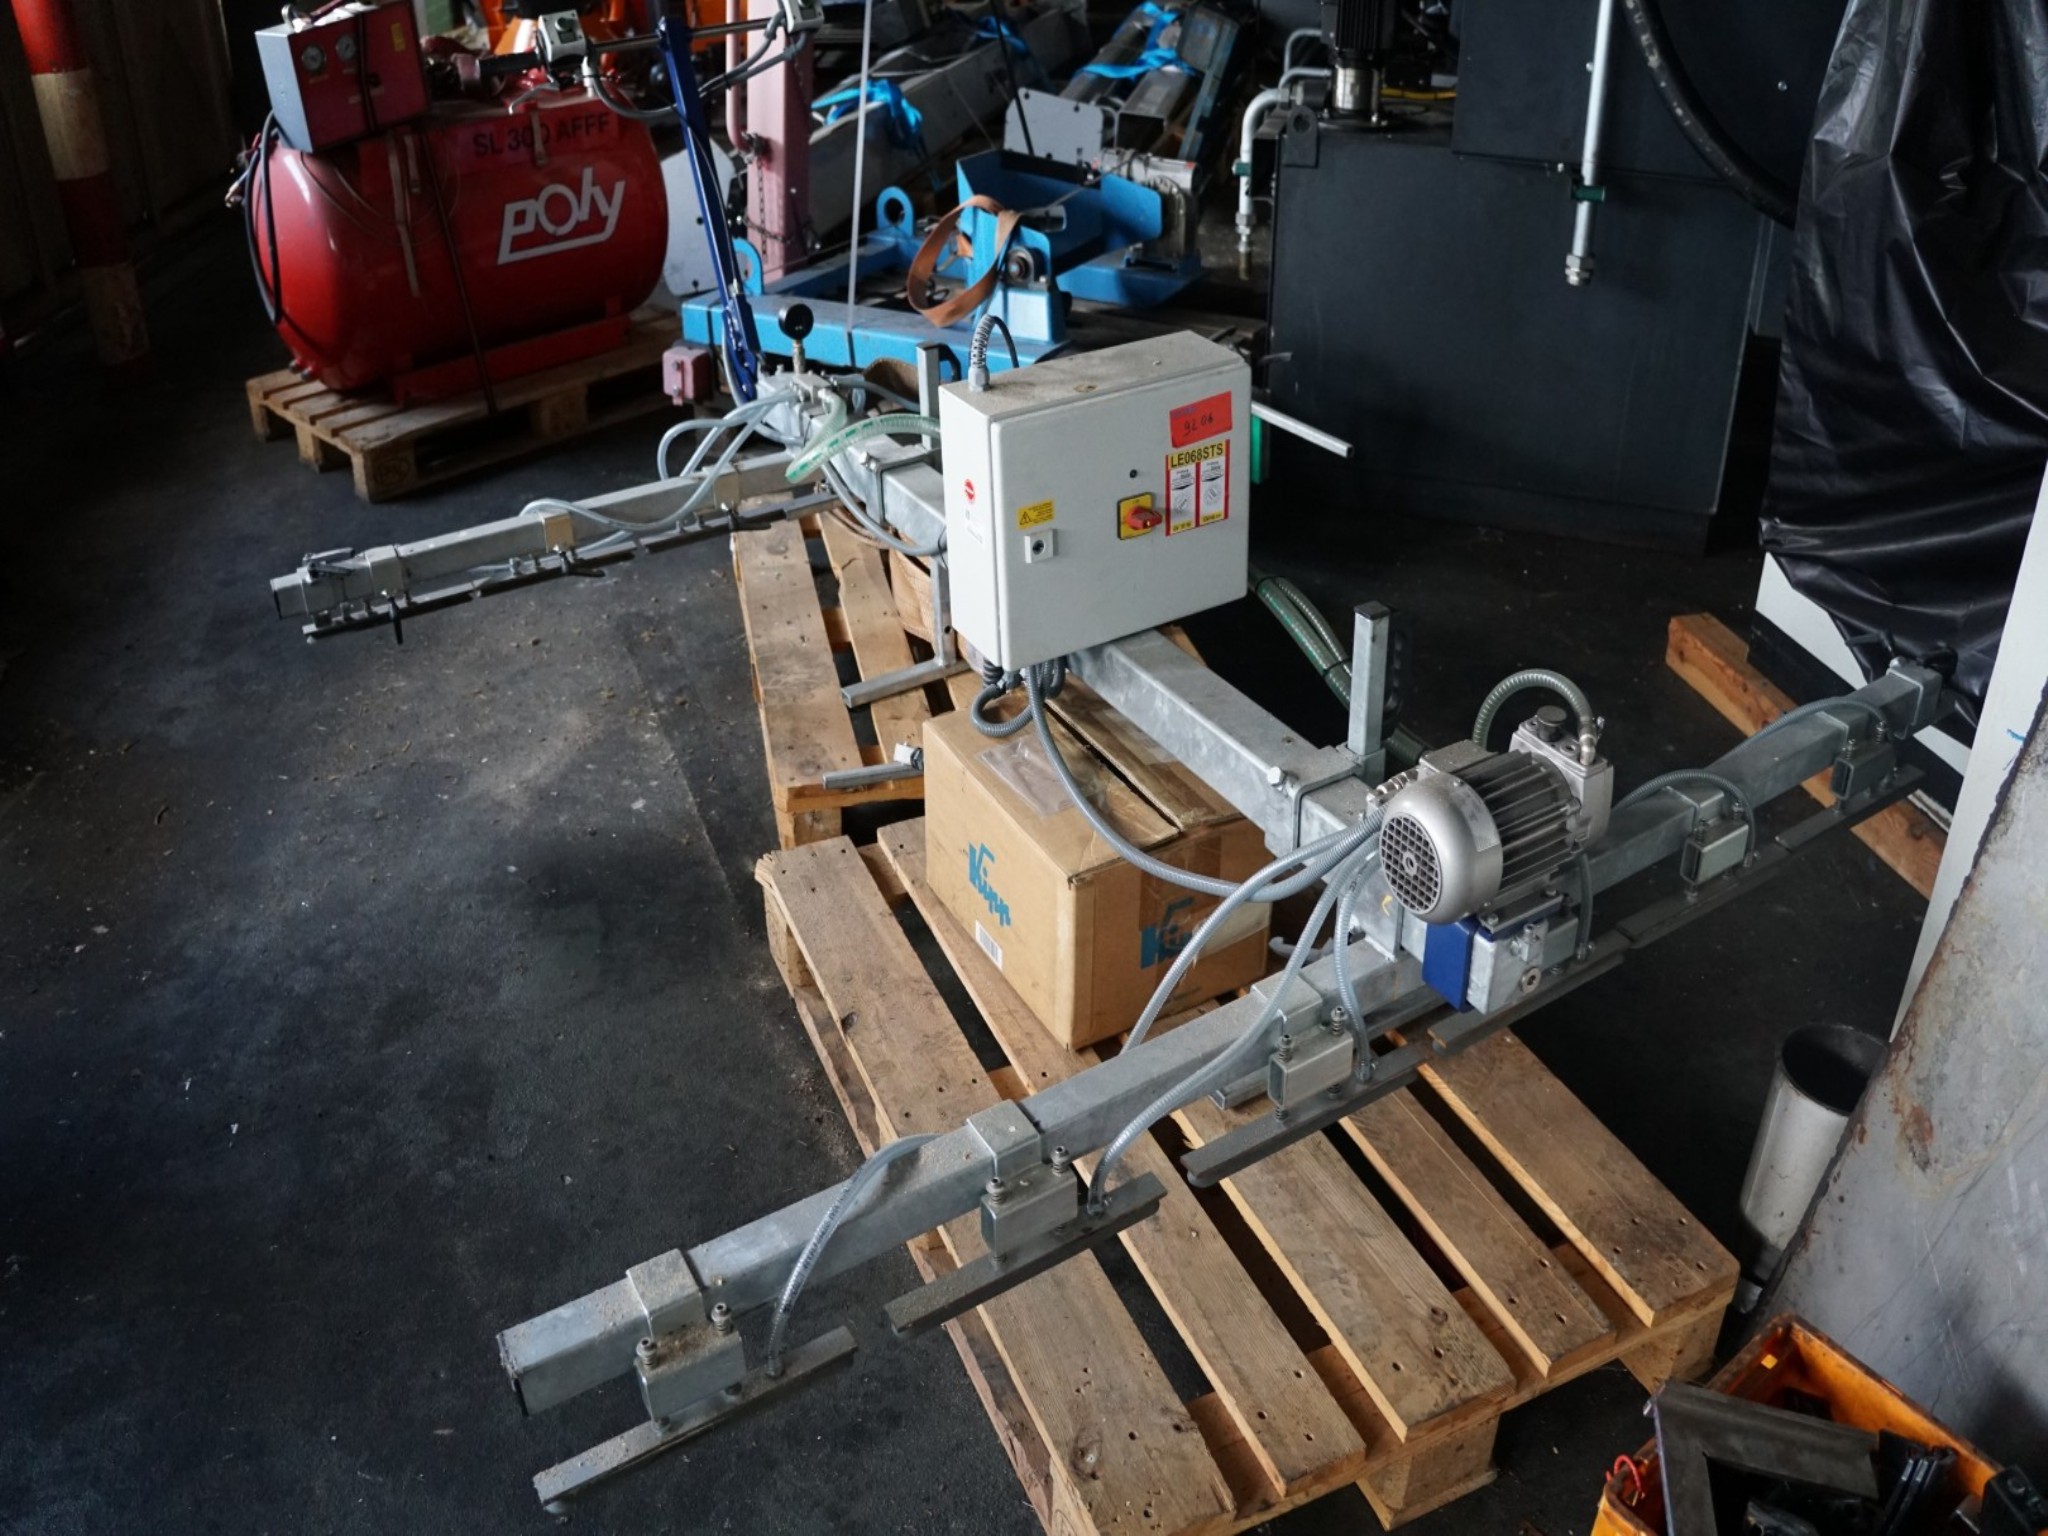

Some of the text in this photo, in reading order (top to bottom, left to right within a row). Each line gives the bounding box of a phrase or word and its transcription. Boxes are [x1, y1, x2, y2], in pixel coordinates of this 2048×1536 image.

[473, 130, 503, 158] SL
[556, 112, 610, 142] AFFF
[1170, 442, 1224, 469] LE068STS
